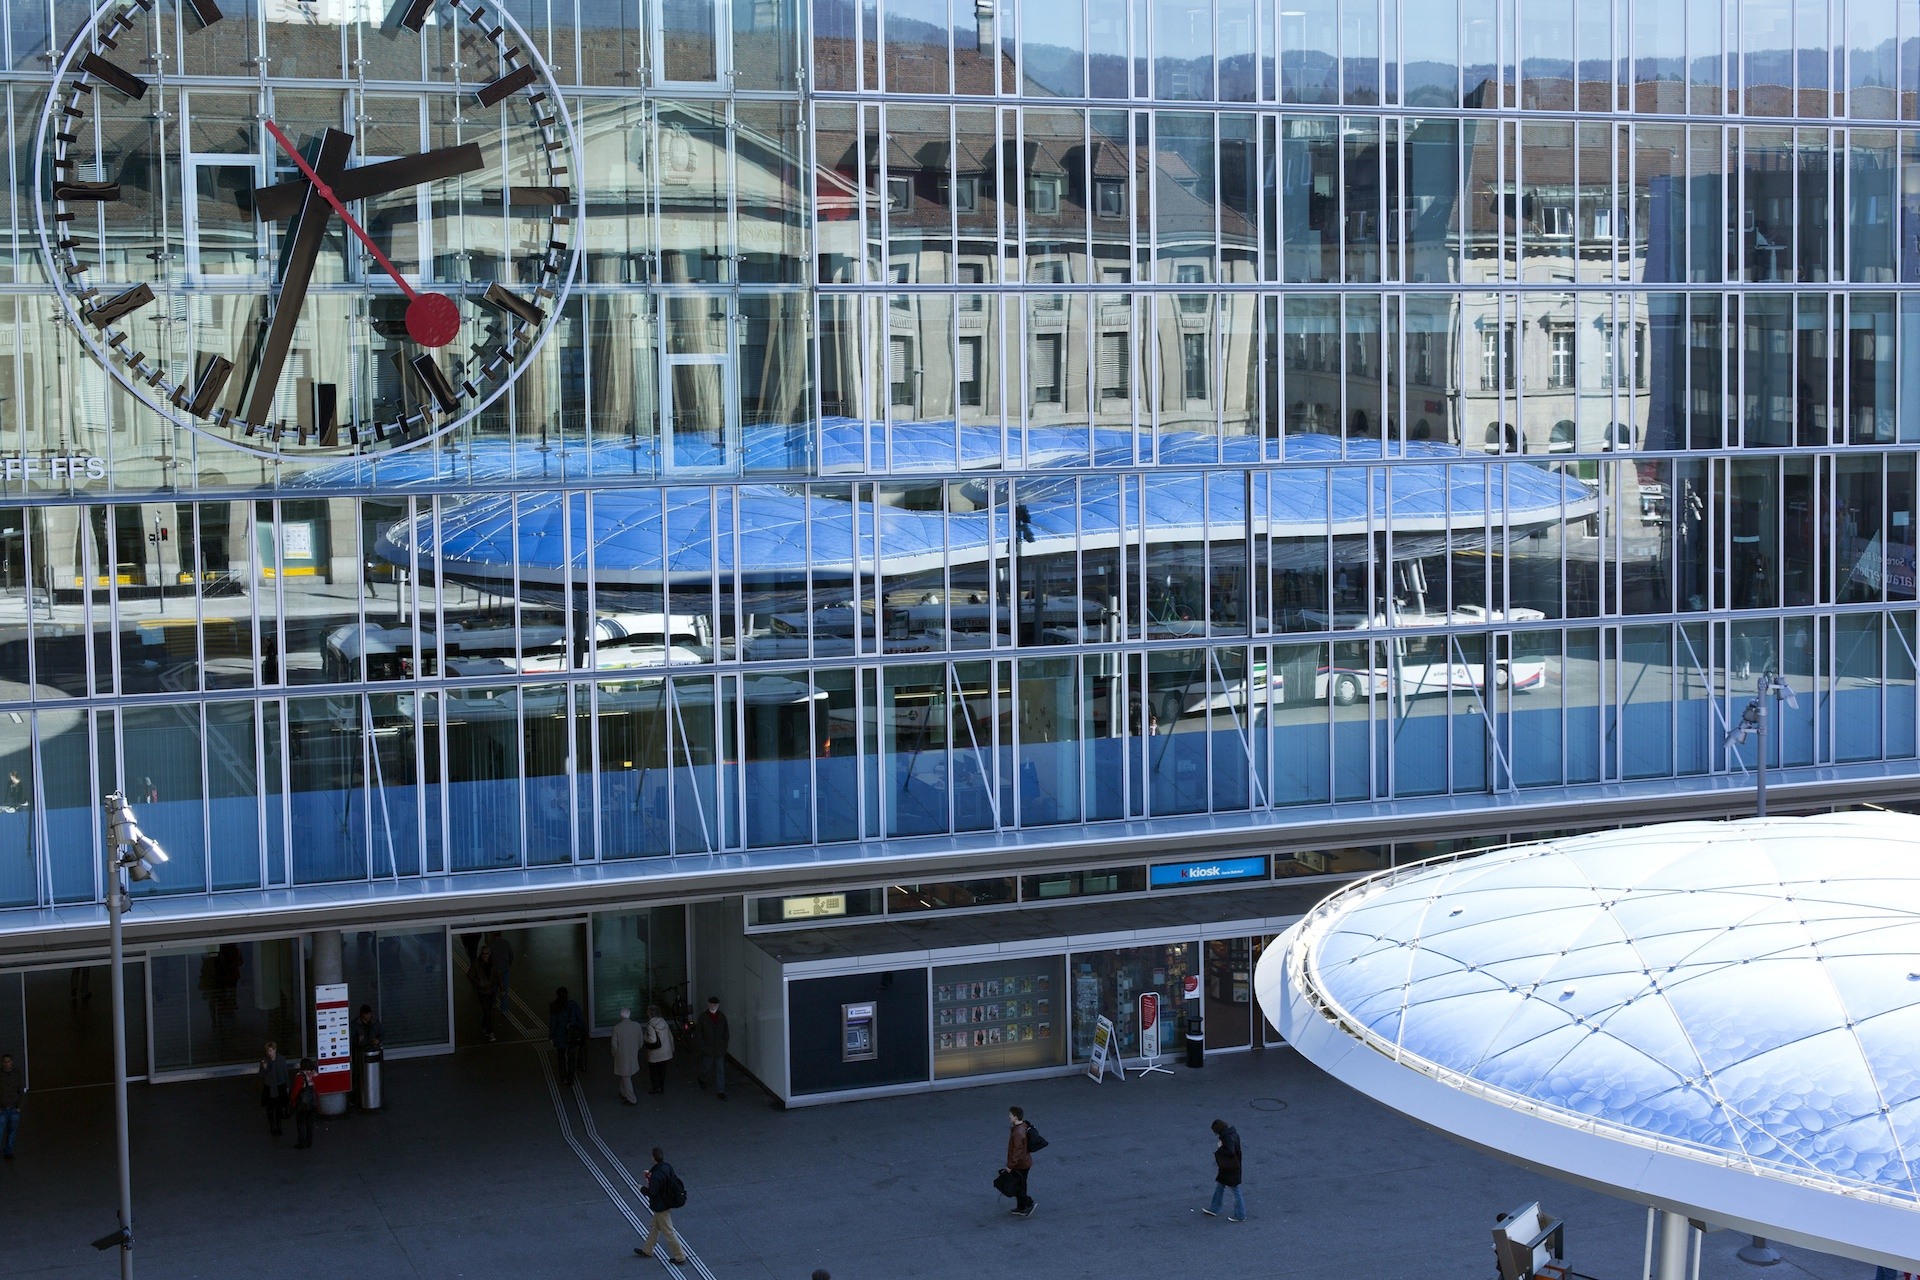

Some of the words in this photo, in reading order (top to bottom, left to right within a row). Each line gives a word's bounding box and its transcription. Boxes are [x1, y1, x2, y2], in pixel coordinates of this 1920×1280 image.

[0, 458, 39, 481] FF
[51, 457, 105, 480] FFS
[1189, 865, 1221, 878] kiosk
